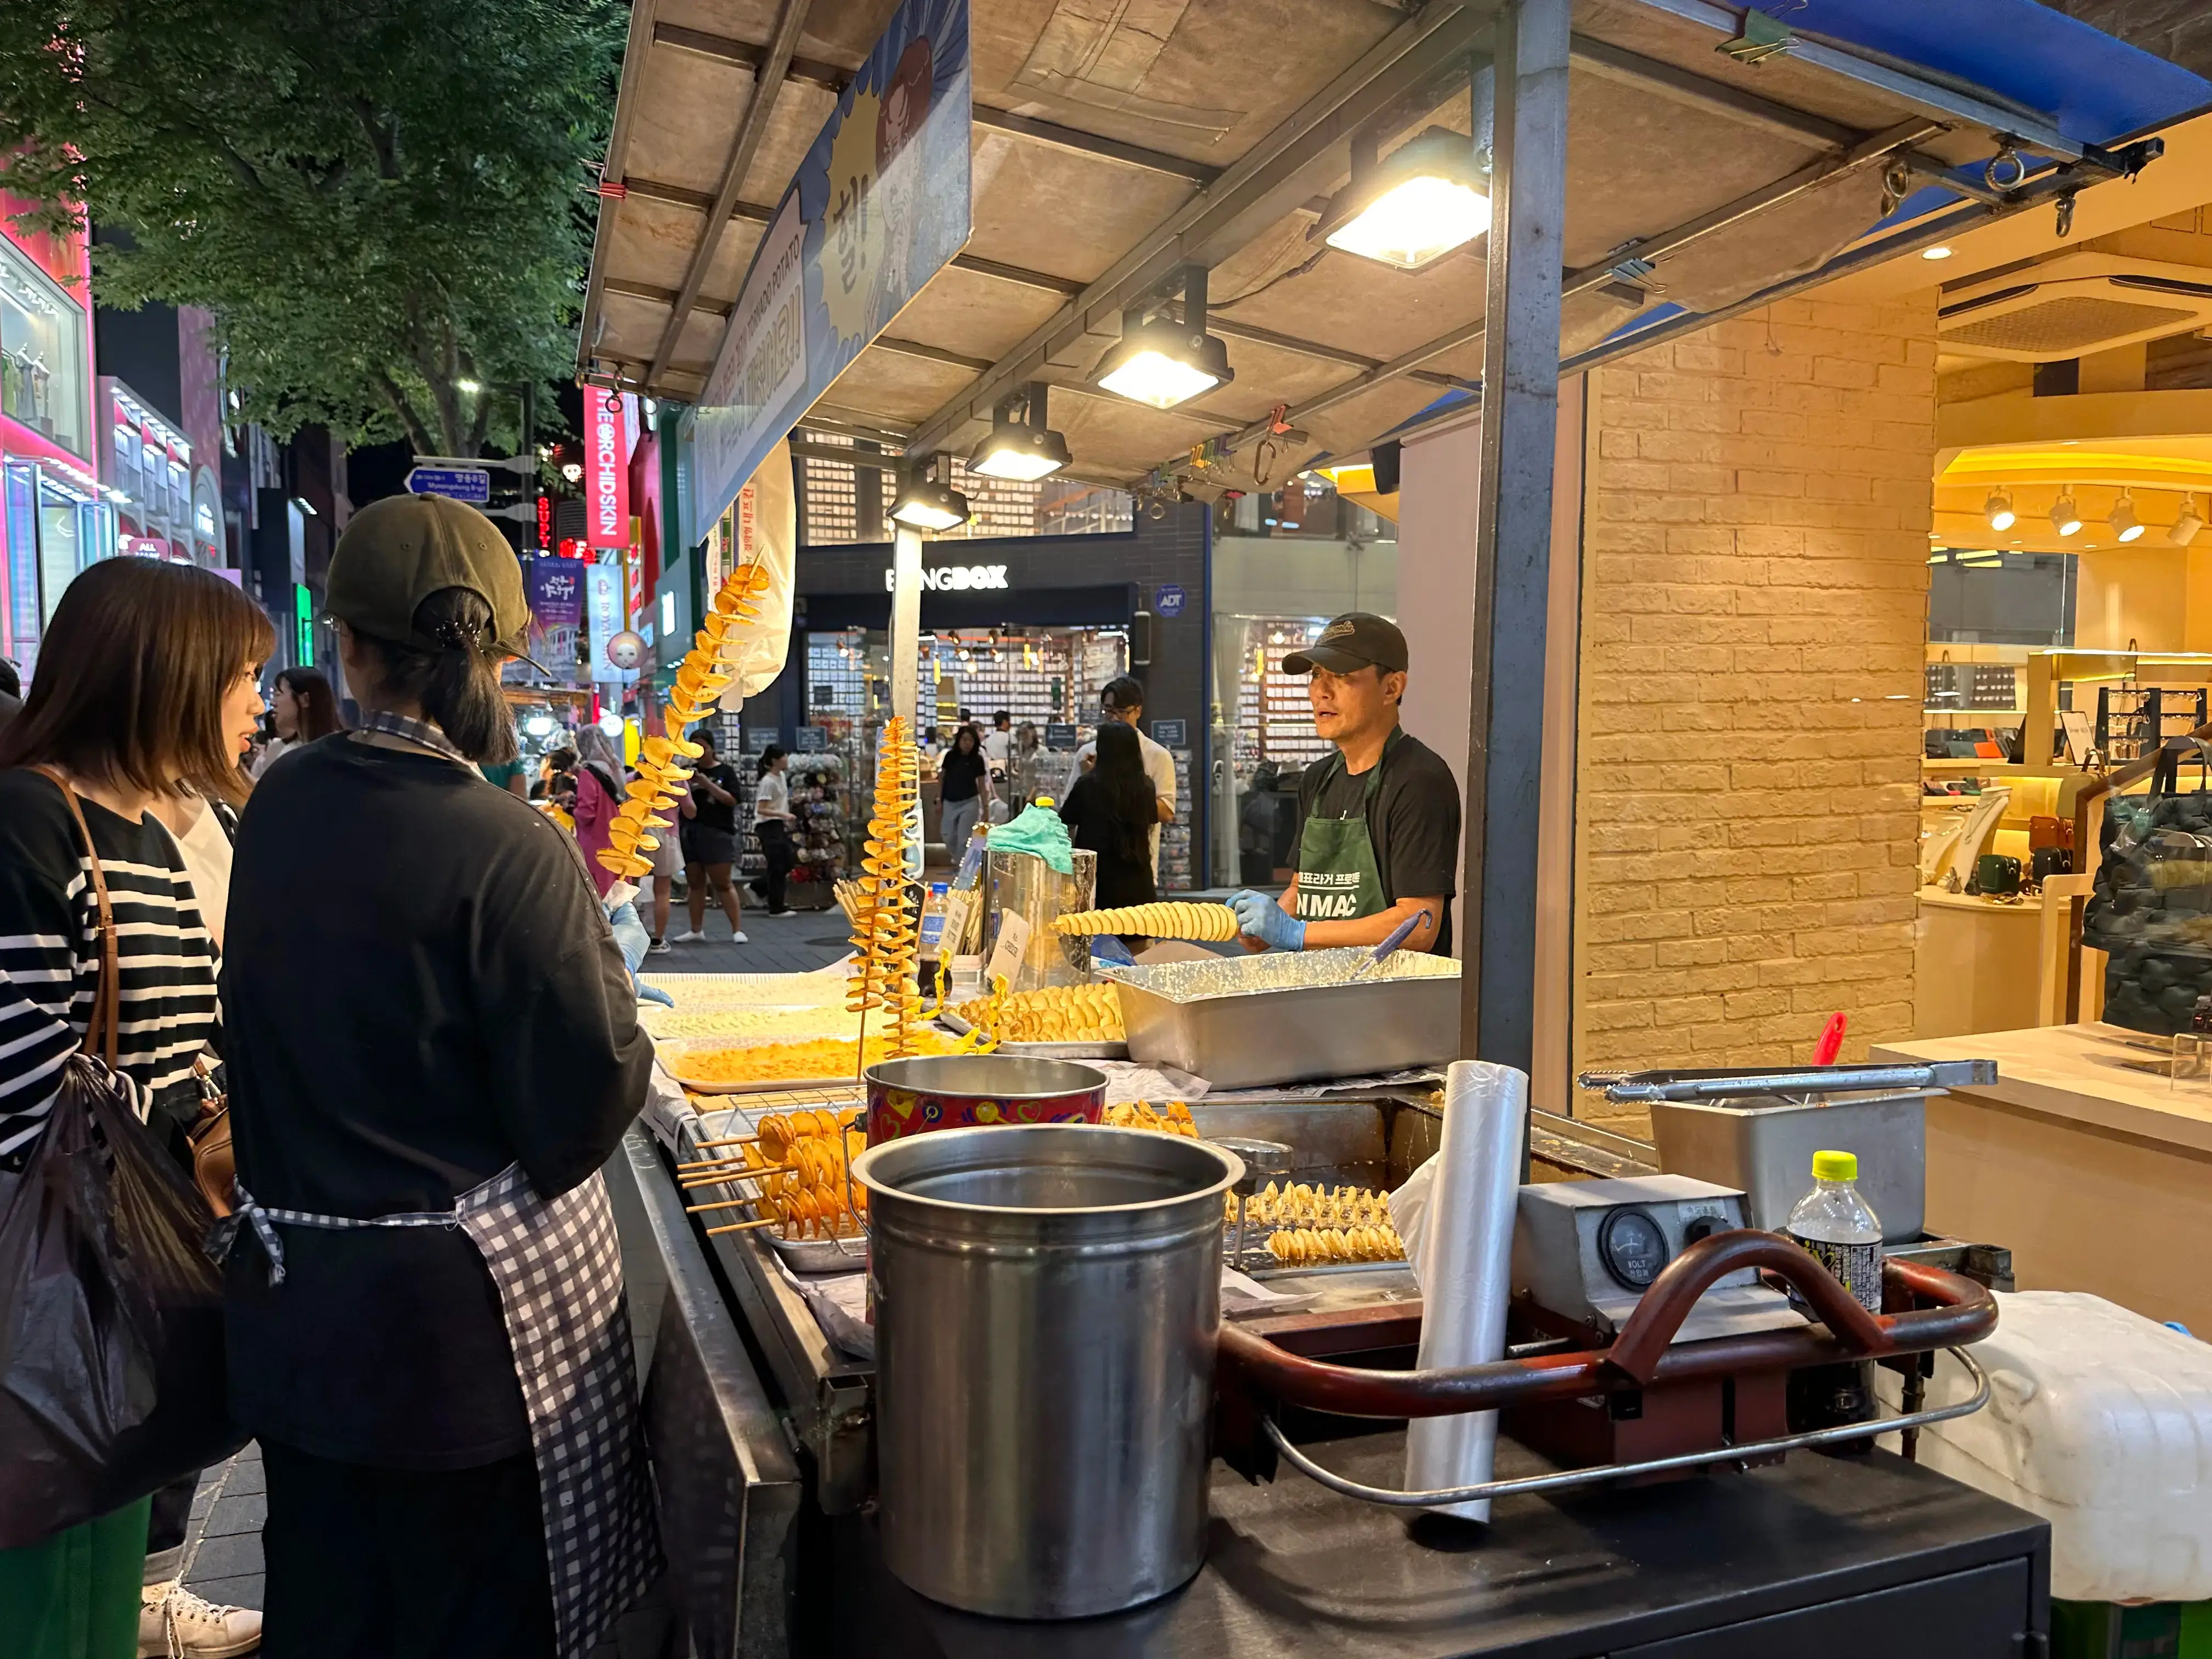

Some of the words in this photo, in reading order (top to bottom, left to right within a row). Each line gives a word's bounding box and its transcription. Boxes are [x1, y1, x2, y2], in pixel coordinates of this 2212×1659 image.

[748, 281, 771, 341] TORNADO
[772, 234, 799, 296] POTATO
[1160, 595, 1182, 607] ADT
[601, 602, 611, 637] ROYAL
[1627, 1260, 1646, 1268] VOLT
